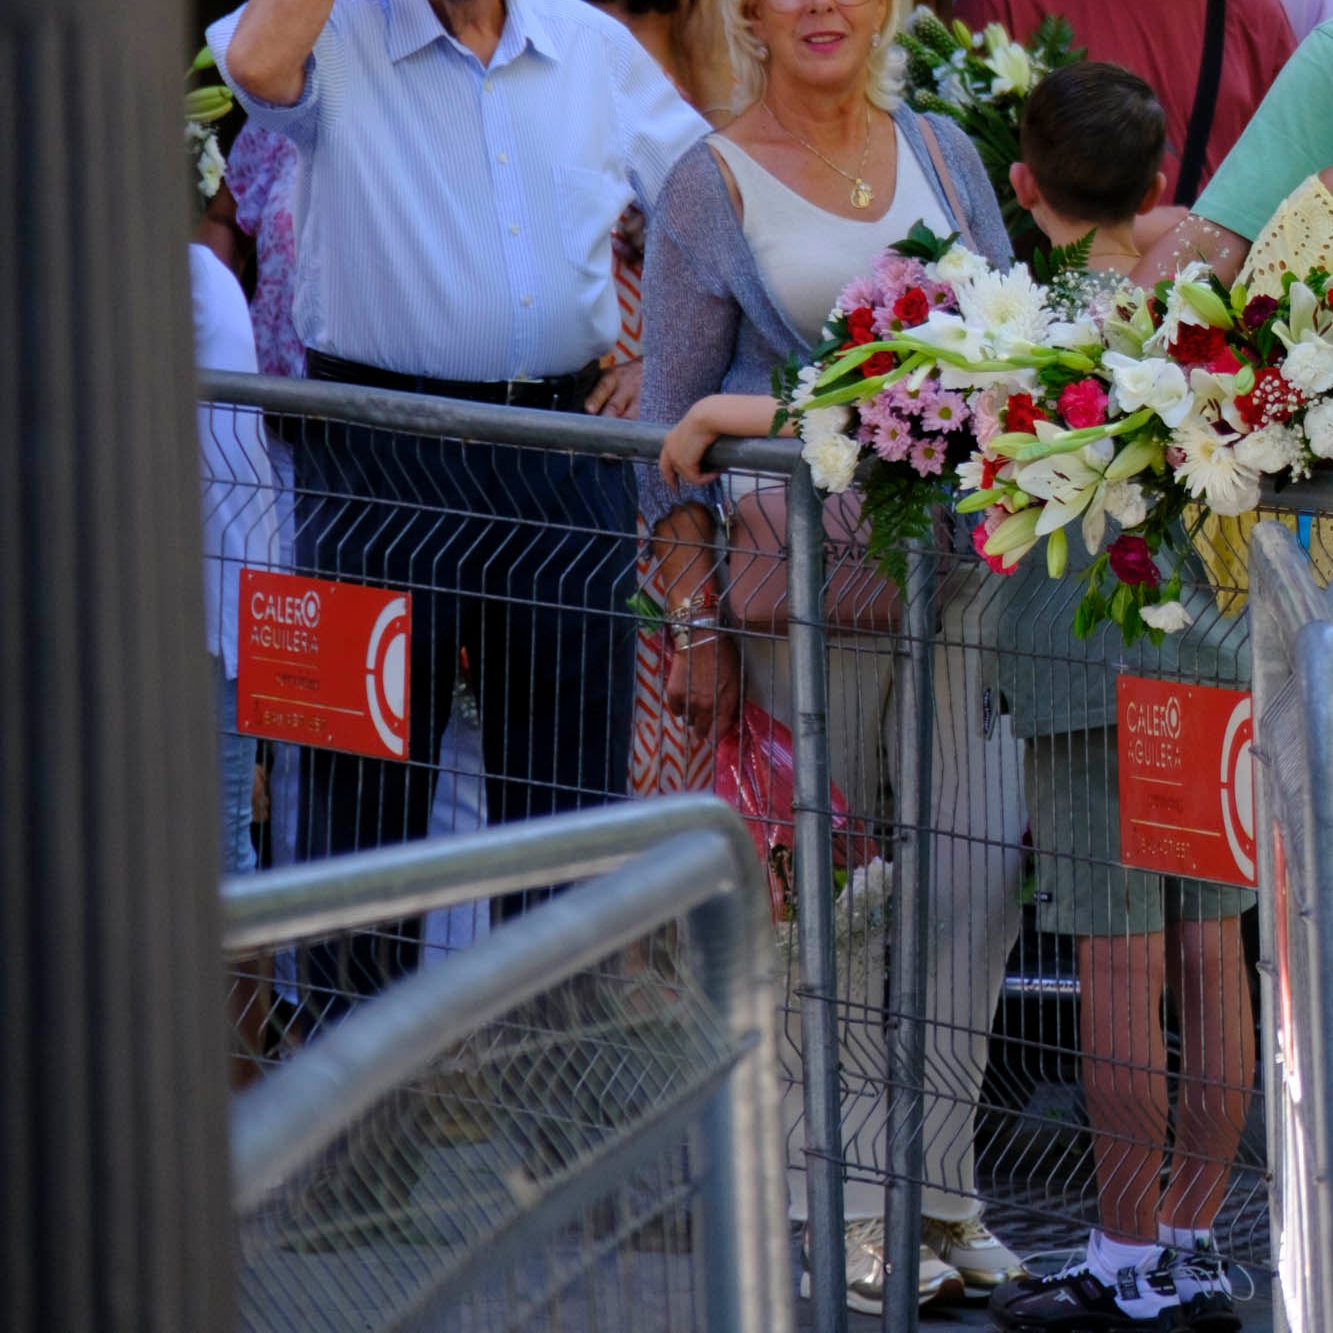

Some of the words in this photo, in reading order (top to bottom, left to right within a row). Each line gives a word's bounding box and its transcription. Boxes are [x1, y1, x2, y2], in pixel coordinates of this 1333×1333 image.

[251, 589, 320, 628] CALERO
[250, 624, 319, 654] AGUILERA
[1126, 696, 1181, 739] CALERO
[1127, 739, 1183, 771] AGUILERA
